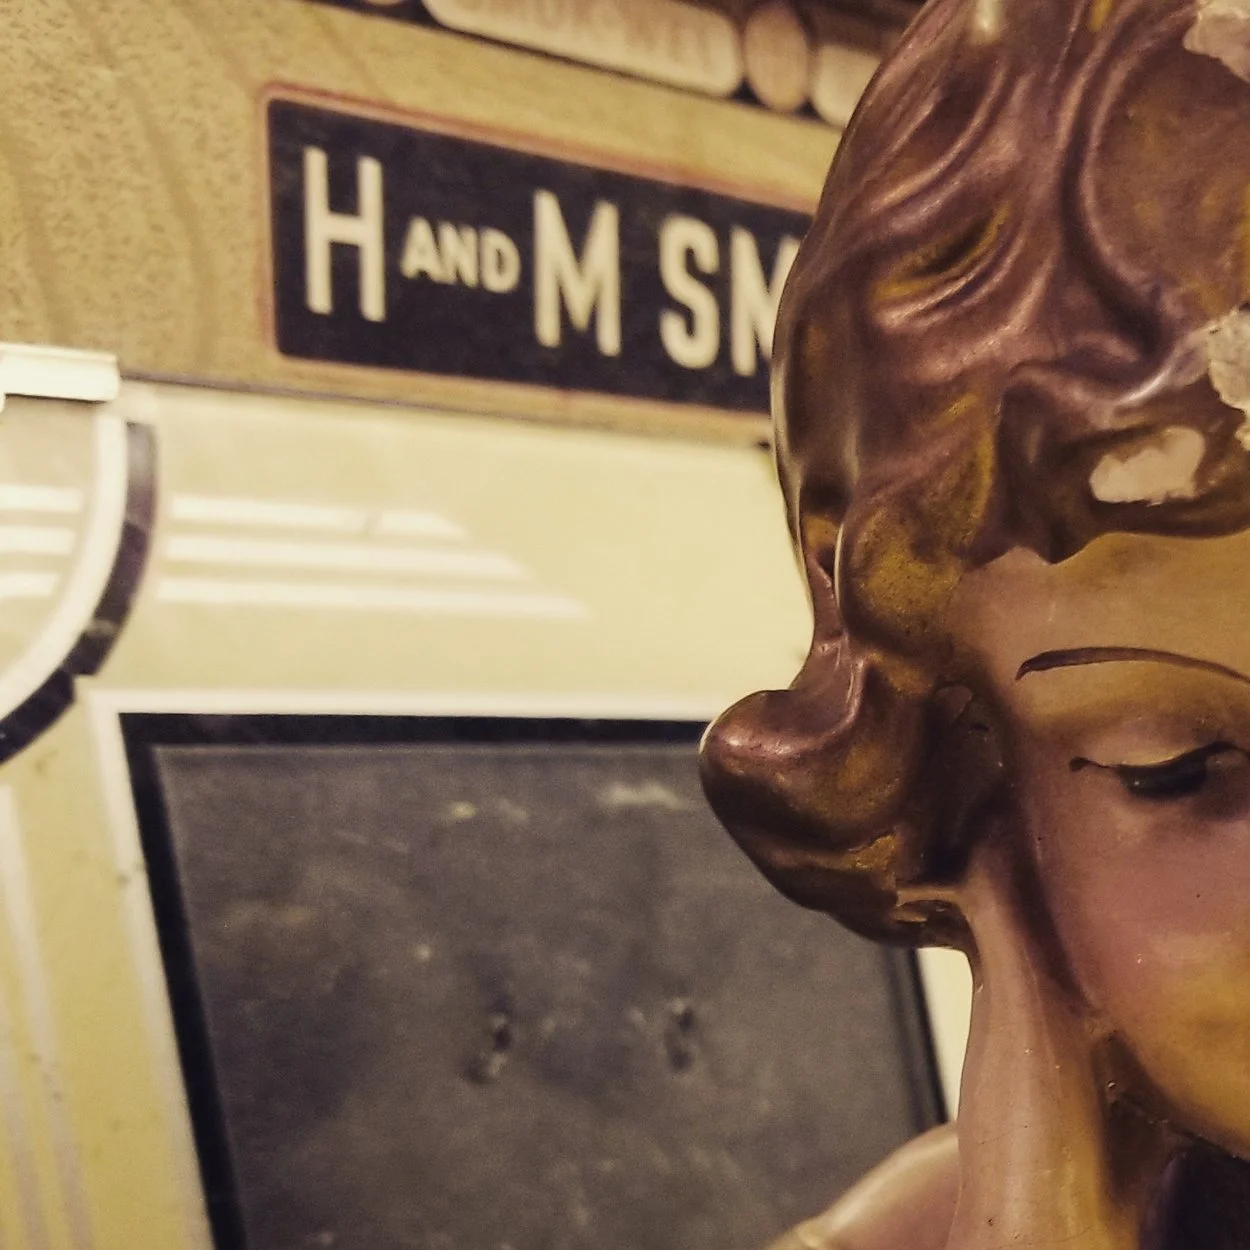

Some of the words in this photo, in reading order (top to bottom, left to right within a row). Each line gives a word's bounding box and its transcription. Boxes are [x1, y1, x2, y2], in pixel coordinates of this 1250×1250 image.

[302, 145, 387, 323] H
[400, 216, 521, 293] AND
[532, 188, 622, 357] M
